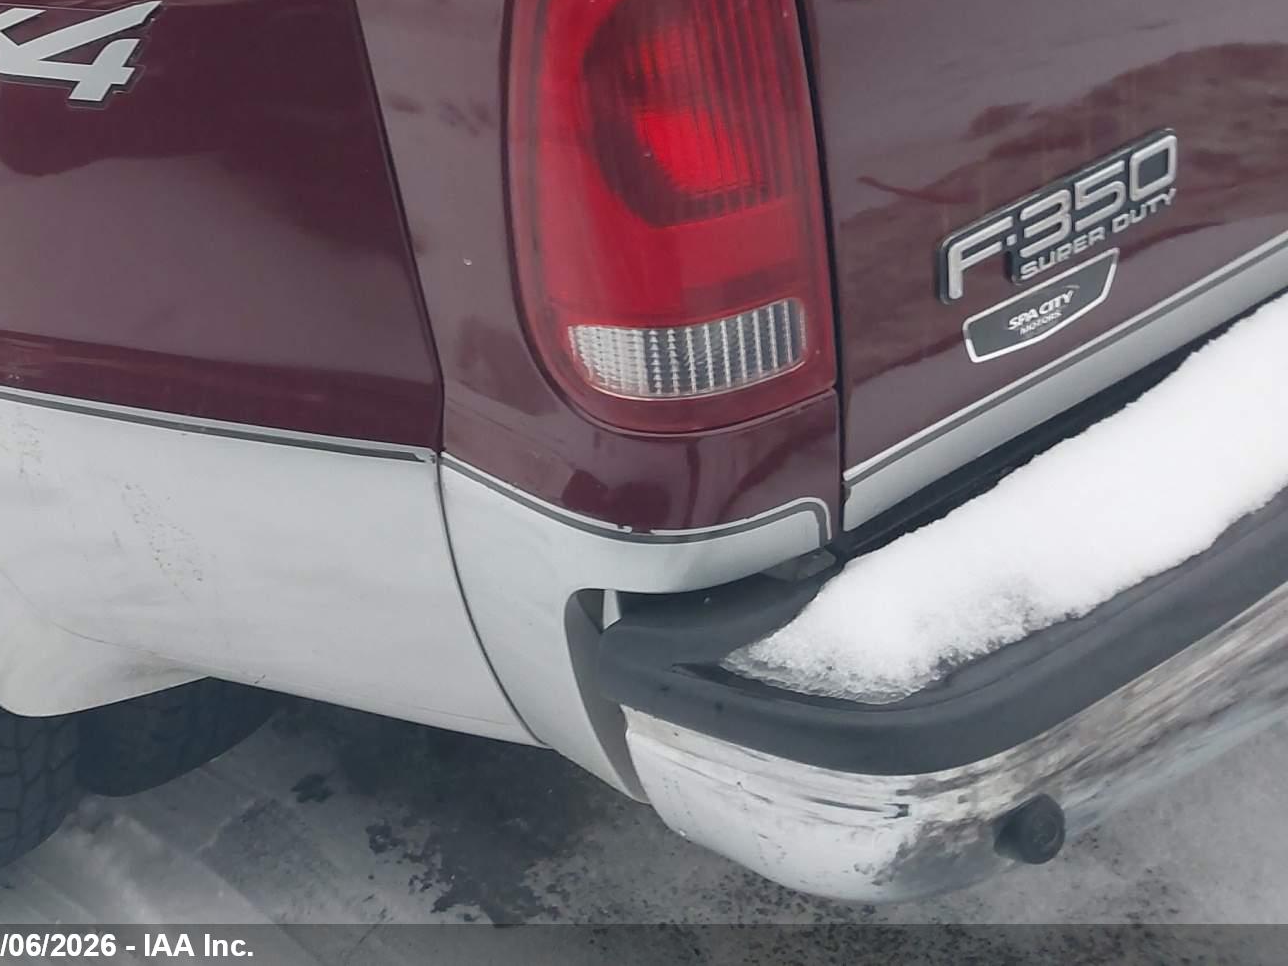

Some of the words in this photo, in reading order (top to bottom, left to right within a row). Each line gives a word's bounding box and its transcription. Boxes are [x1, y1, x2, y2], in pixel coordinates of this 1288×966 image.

[1020, 226, 1106, 281] SUPER
[1112, 188, 1177, 234] DUTY
[1008, 308, 1039, 330] SPA
[1039, 290, 1074, 315] CITY
[1020, 310, 1062, 335] MOTORS
